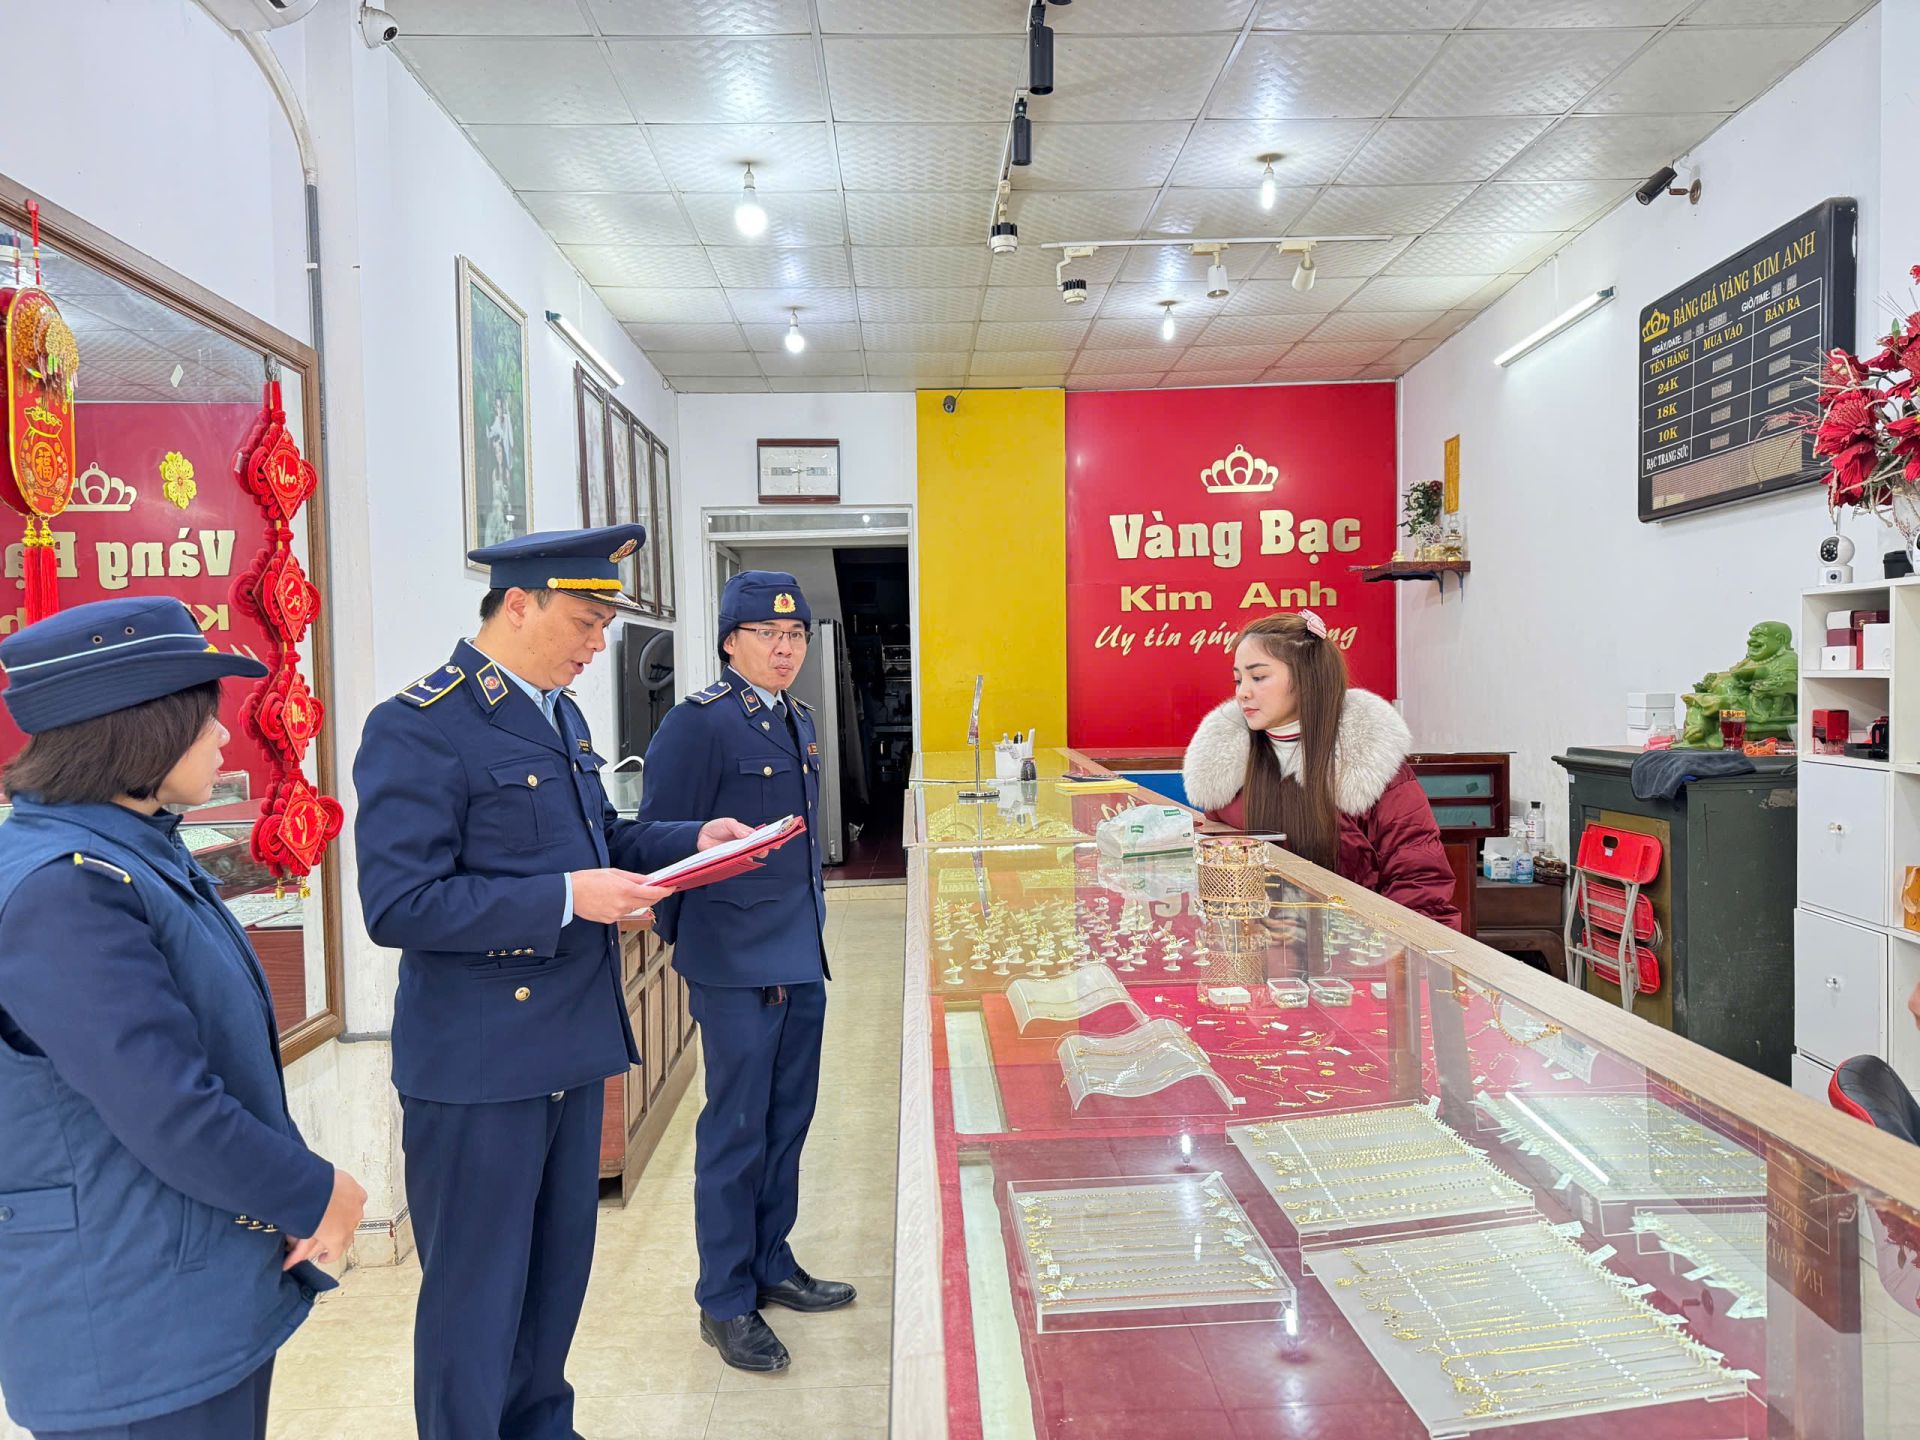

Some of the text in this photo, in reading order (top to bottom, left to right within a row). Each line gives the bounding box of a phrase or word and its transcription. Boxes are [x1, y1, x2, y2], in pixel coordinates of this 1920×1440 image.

[1700, 283, 1718, 313] GIÁ
[1720, 270, 1749, 302] VÀNG
[1753, 252, 1780, 286] KIM
[1782, 231, 1816, 270] ANH
[1787, 295, 1801, 313] RA
[1704, 333, 1723, 351] MUA
[1650, 359, 1666, 375] TÊN
[1657, 376, 1679, 395] 24K
[1657, 403, 1678, 420] 18K
[1658, 426, 1678, 443] 10K
[1658, 449, 1677, 466] TRANG
[1109, 509, 1361, 568] Vàng Bạc
[1121, 581, 1337, 611] Kim Anh
[1094, 624, 1136, 656] Uy
[1143, 622, 1182, 647] tín
